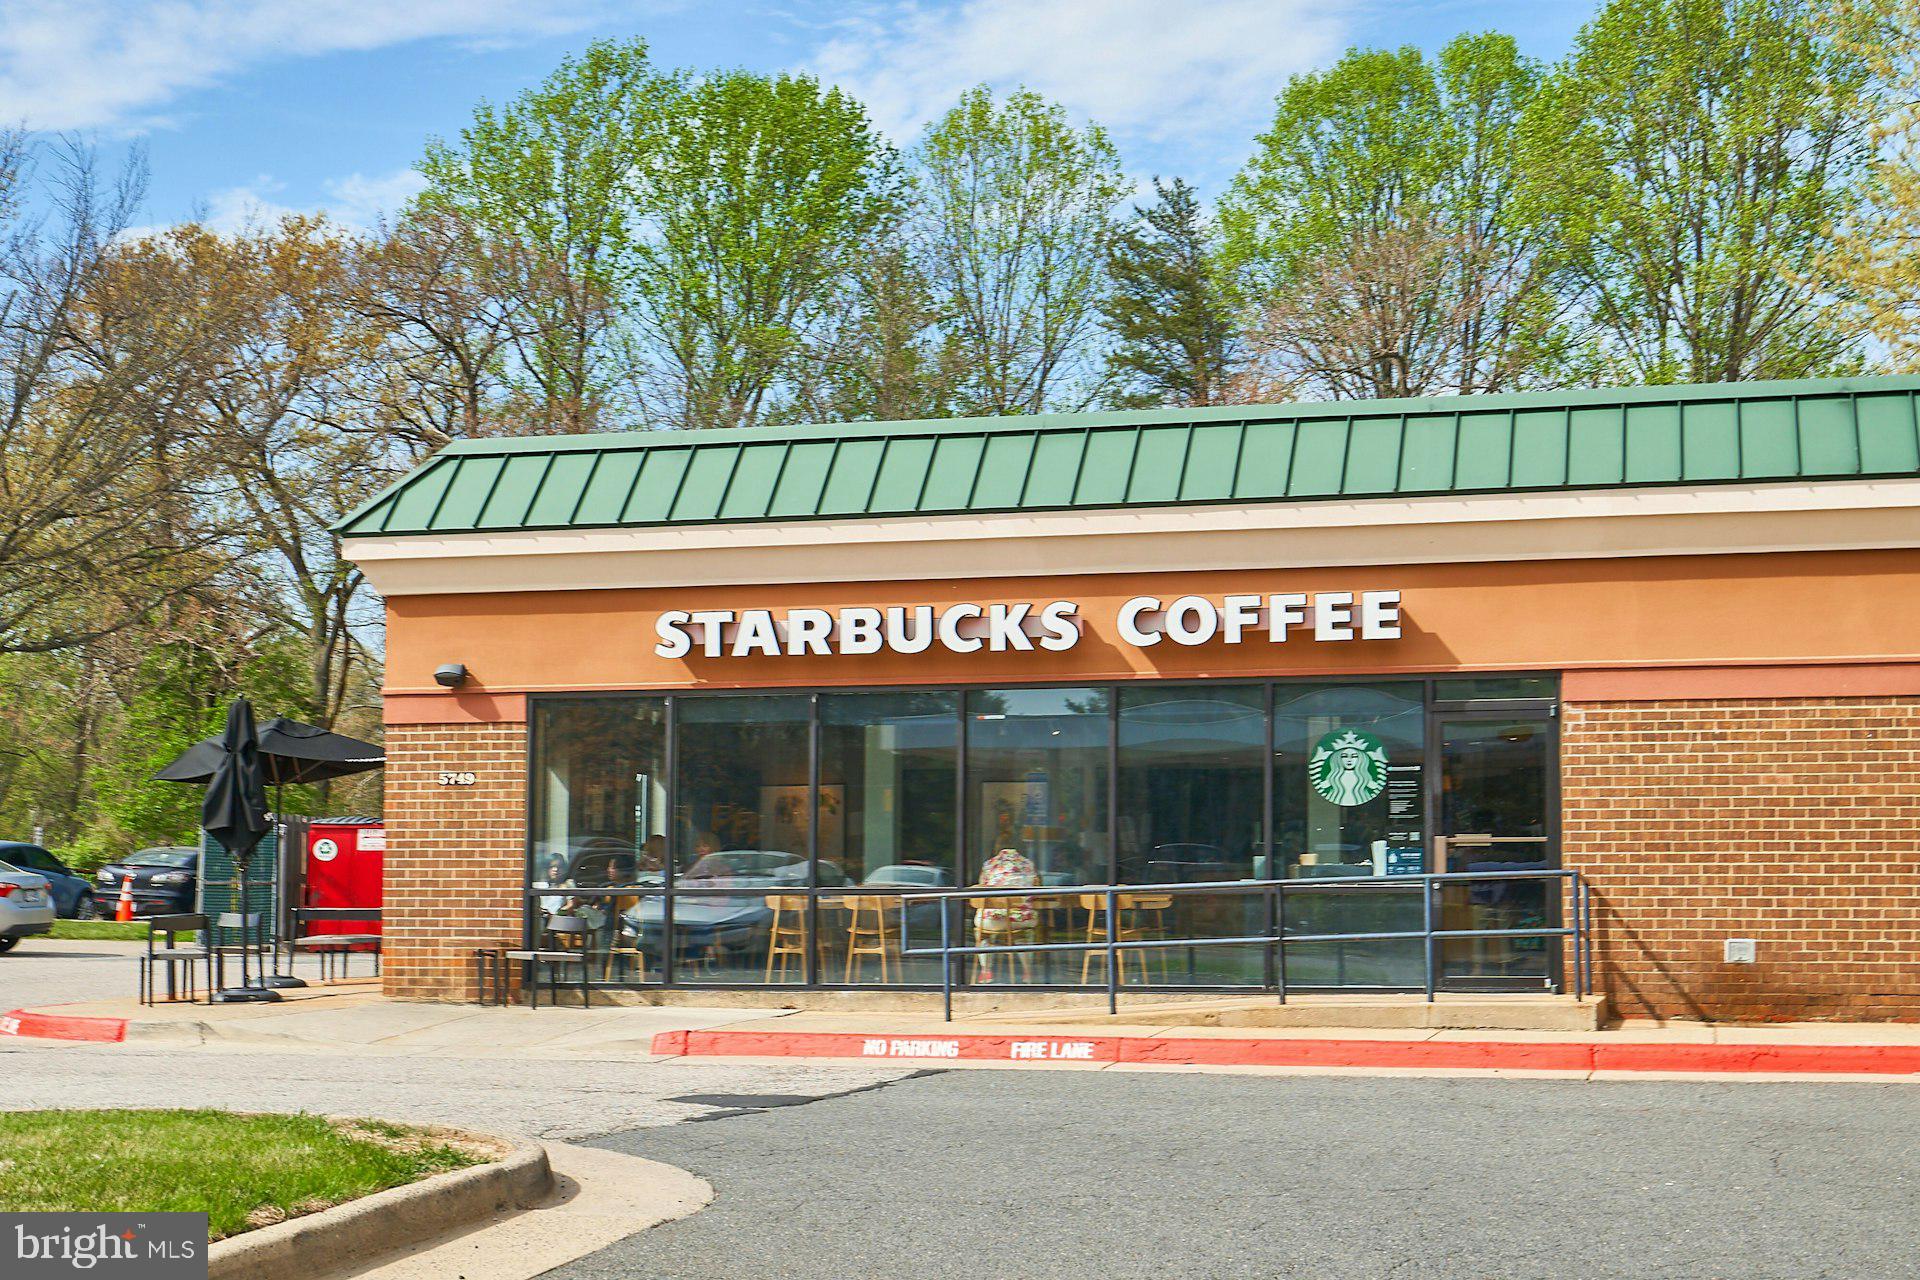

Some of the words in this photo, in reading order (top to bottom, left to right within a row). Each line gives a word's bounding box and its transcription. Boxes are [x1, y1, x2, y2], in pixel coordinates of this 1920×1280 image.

[654, 601, 1080, 659] STARBUCKS
[1117, 590, 1402, 647] COFFEE
[438, 772, 476, 785] 5749
[862, 1039, 887, 1056] NO
[890, 1040, 959, 1057] PARKING
[1010, 1042, 1048, 1058] FIRE
[1050, 1042, 1094, 1059] LANE
